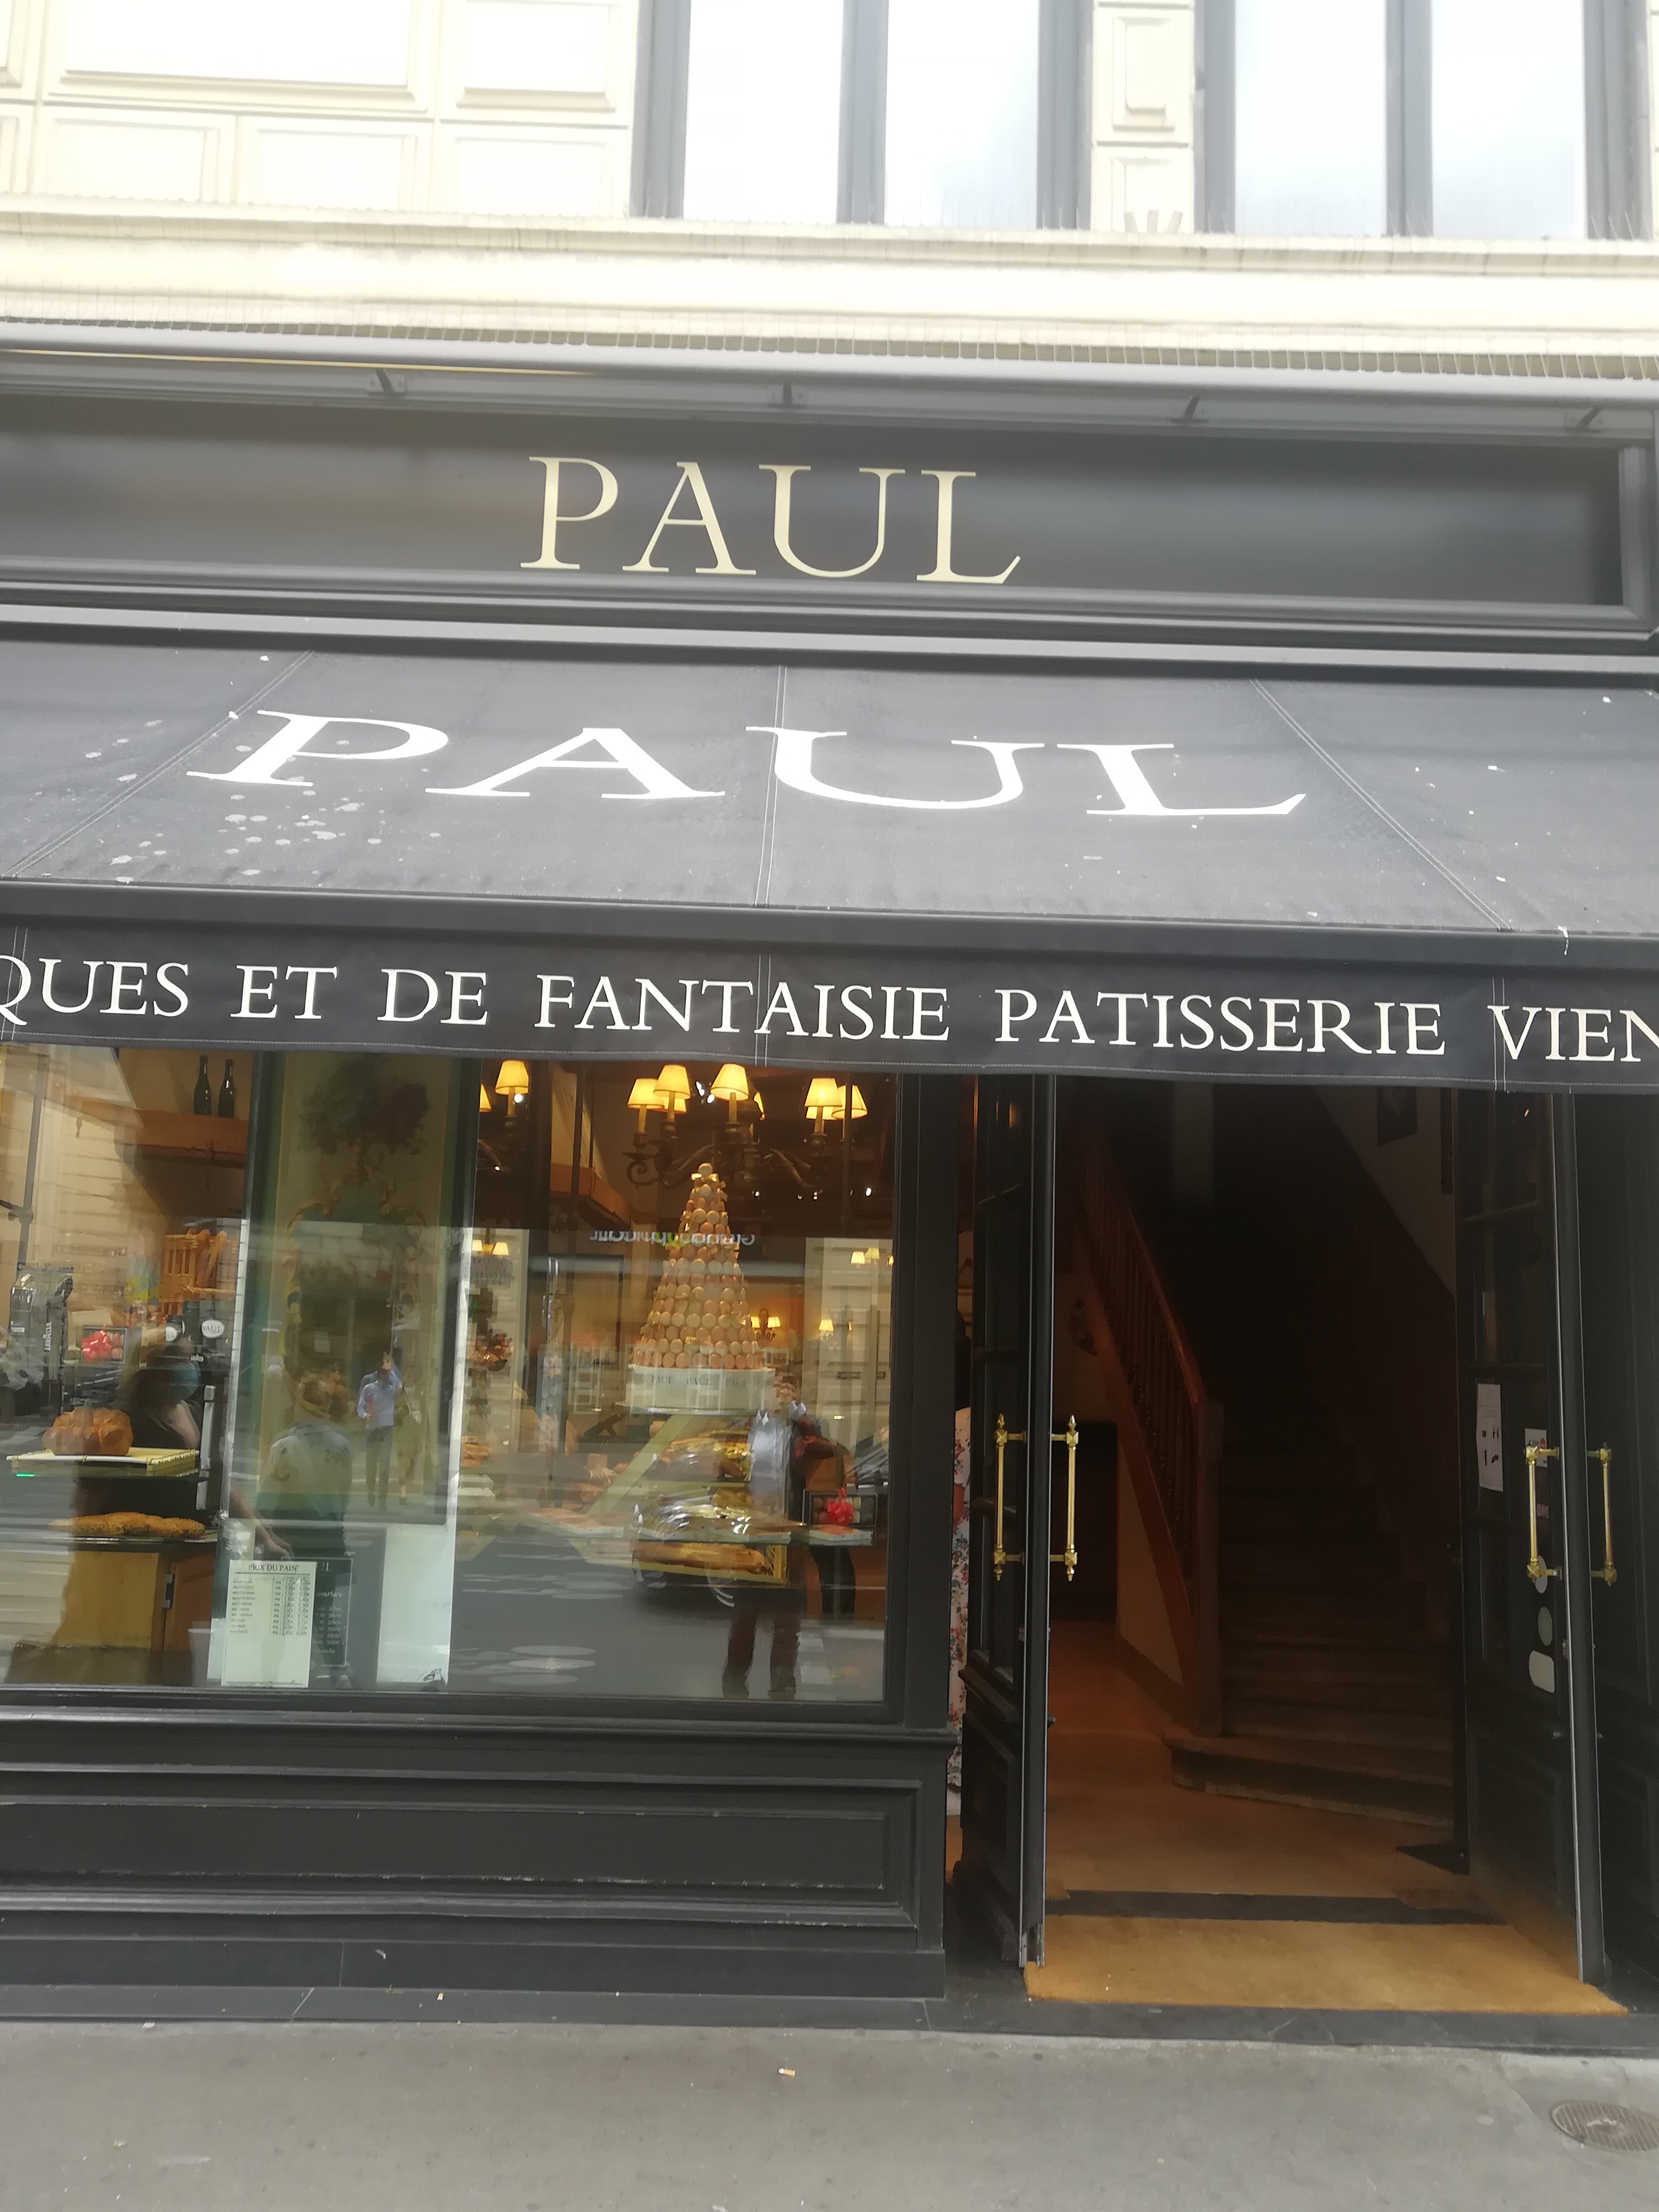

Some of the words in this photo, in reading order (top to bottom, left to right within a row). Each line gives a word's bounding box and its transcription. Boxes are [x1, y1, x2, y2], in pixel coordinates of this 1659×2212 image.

[520, 457, 1021, 584] PAUL
[186, 710, 1306, 818] PAUL
[230, 965, 338, 1020] ET
[376, 968, 488, 1026] DE
[533, 974, 950, 1041] FANTAISIE
[995, 989, 1445, 1056] PATISSERIE
[1487, 1005, 1659, 1063] VIEN
[651, 1374, 674, 1384] PAUL
